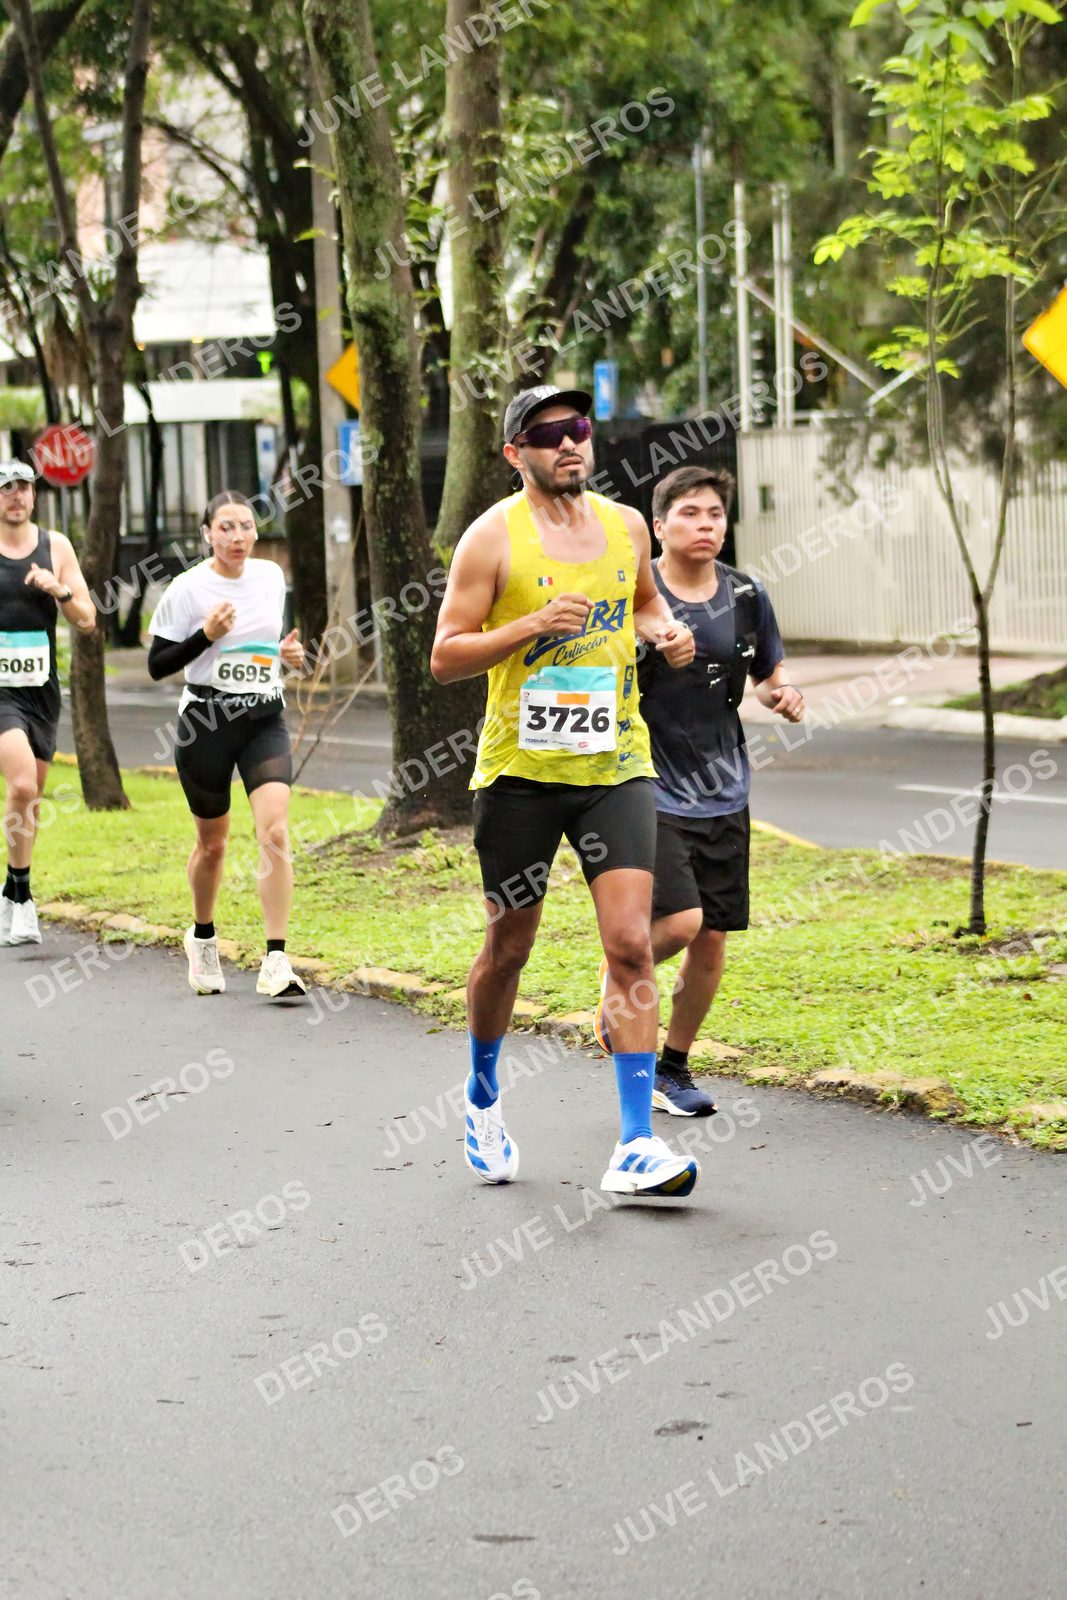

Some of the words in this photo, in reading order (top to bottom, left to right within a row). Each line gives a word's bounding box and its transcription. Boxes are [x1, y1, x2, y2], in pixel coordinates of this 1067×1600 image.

[0, 657, 44, 673] 6081
[218, 663, 271, 683] 6695
[526, 705, 610, 733] 3726
